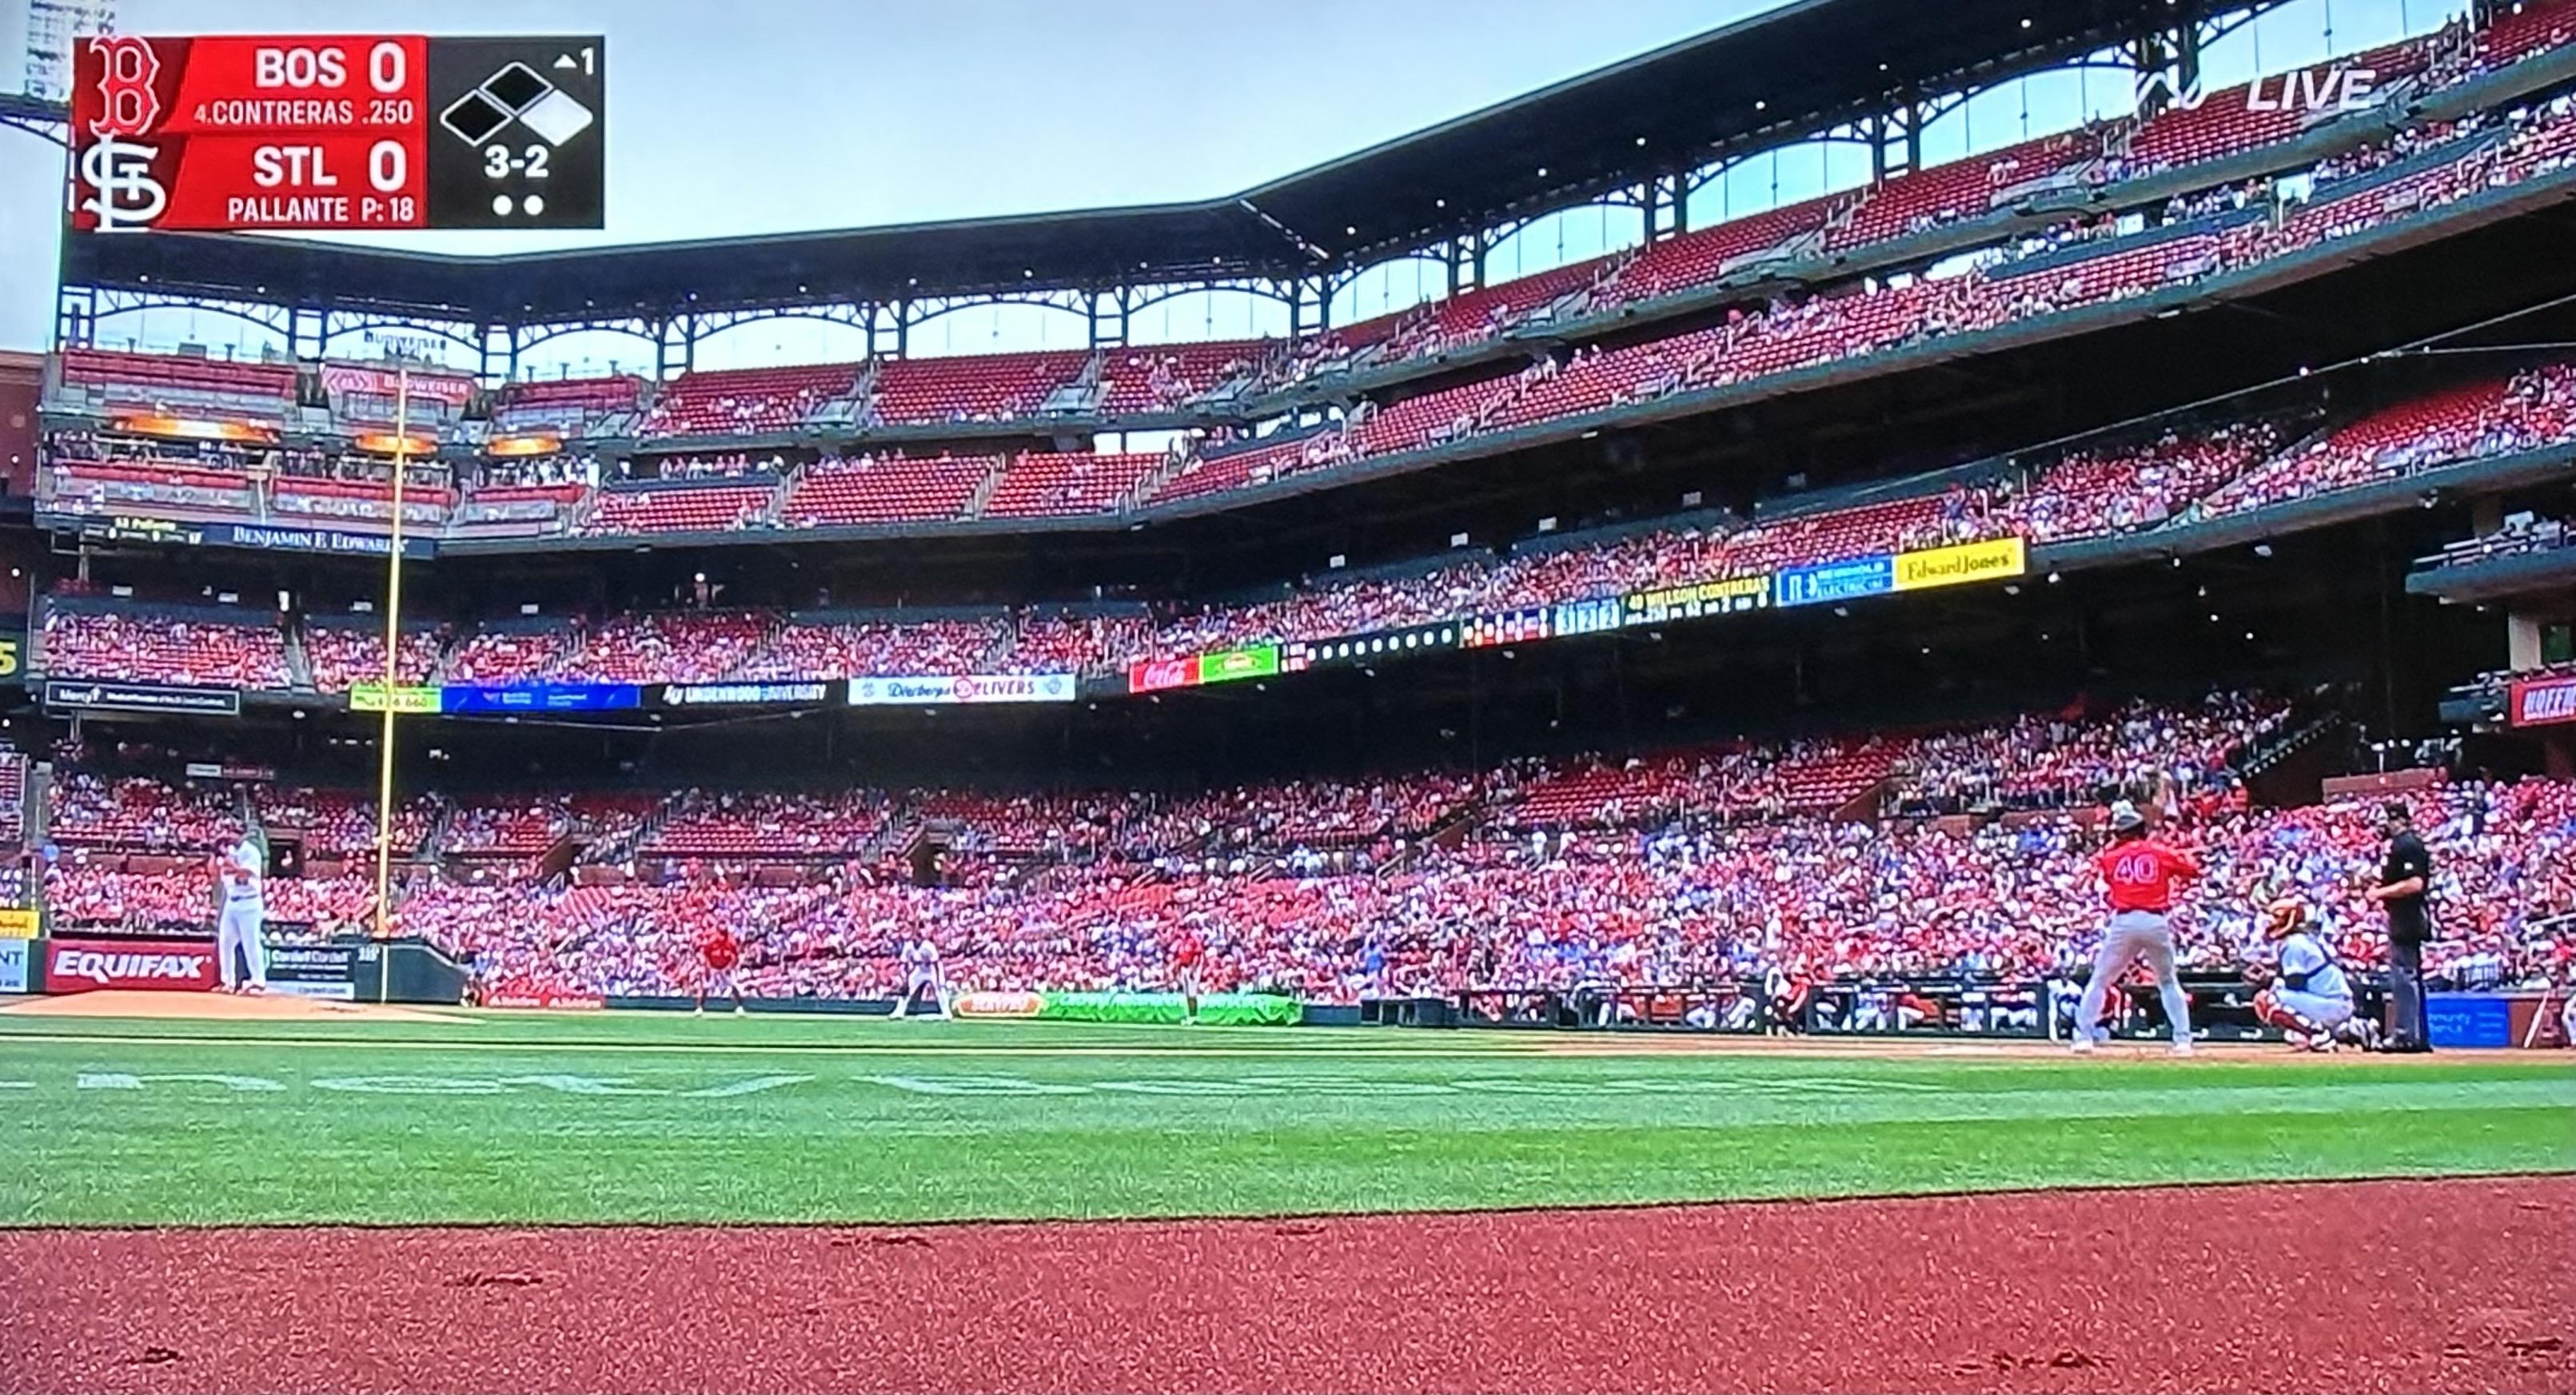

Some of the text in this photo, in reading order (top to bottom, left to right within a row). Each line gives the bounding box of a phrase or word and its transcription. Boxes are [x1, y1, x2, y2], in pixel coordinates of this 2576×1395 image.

[233, 526, 311, 548] BENJAMIN
[1908, 552, 2010, 581] Edward Jones
[1645, 588, 1697, 608] WILLSON
[1698, 576, 1770, 600] CONTRERAS
[2113, 853, 2159, 886] 40
[54, 950, 205, 983] EQUIFAX
